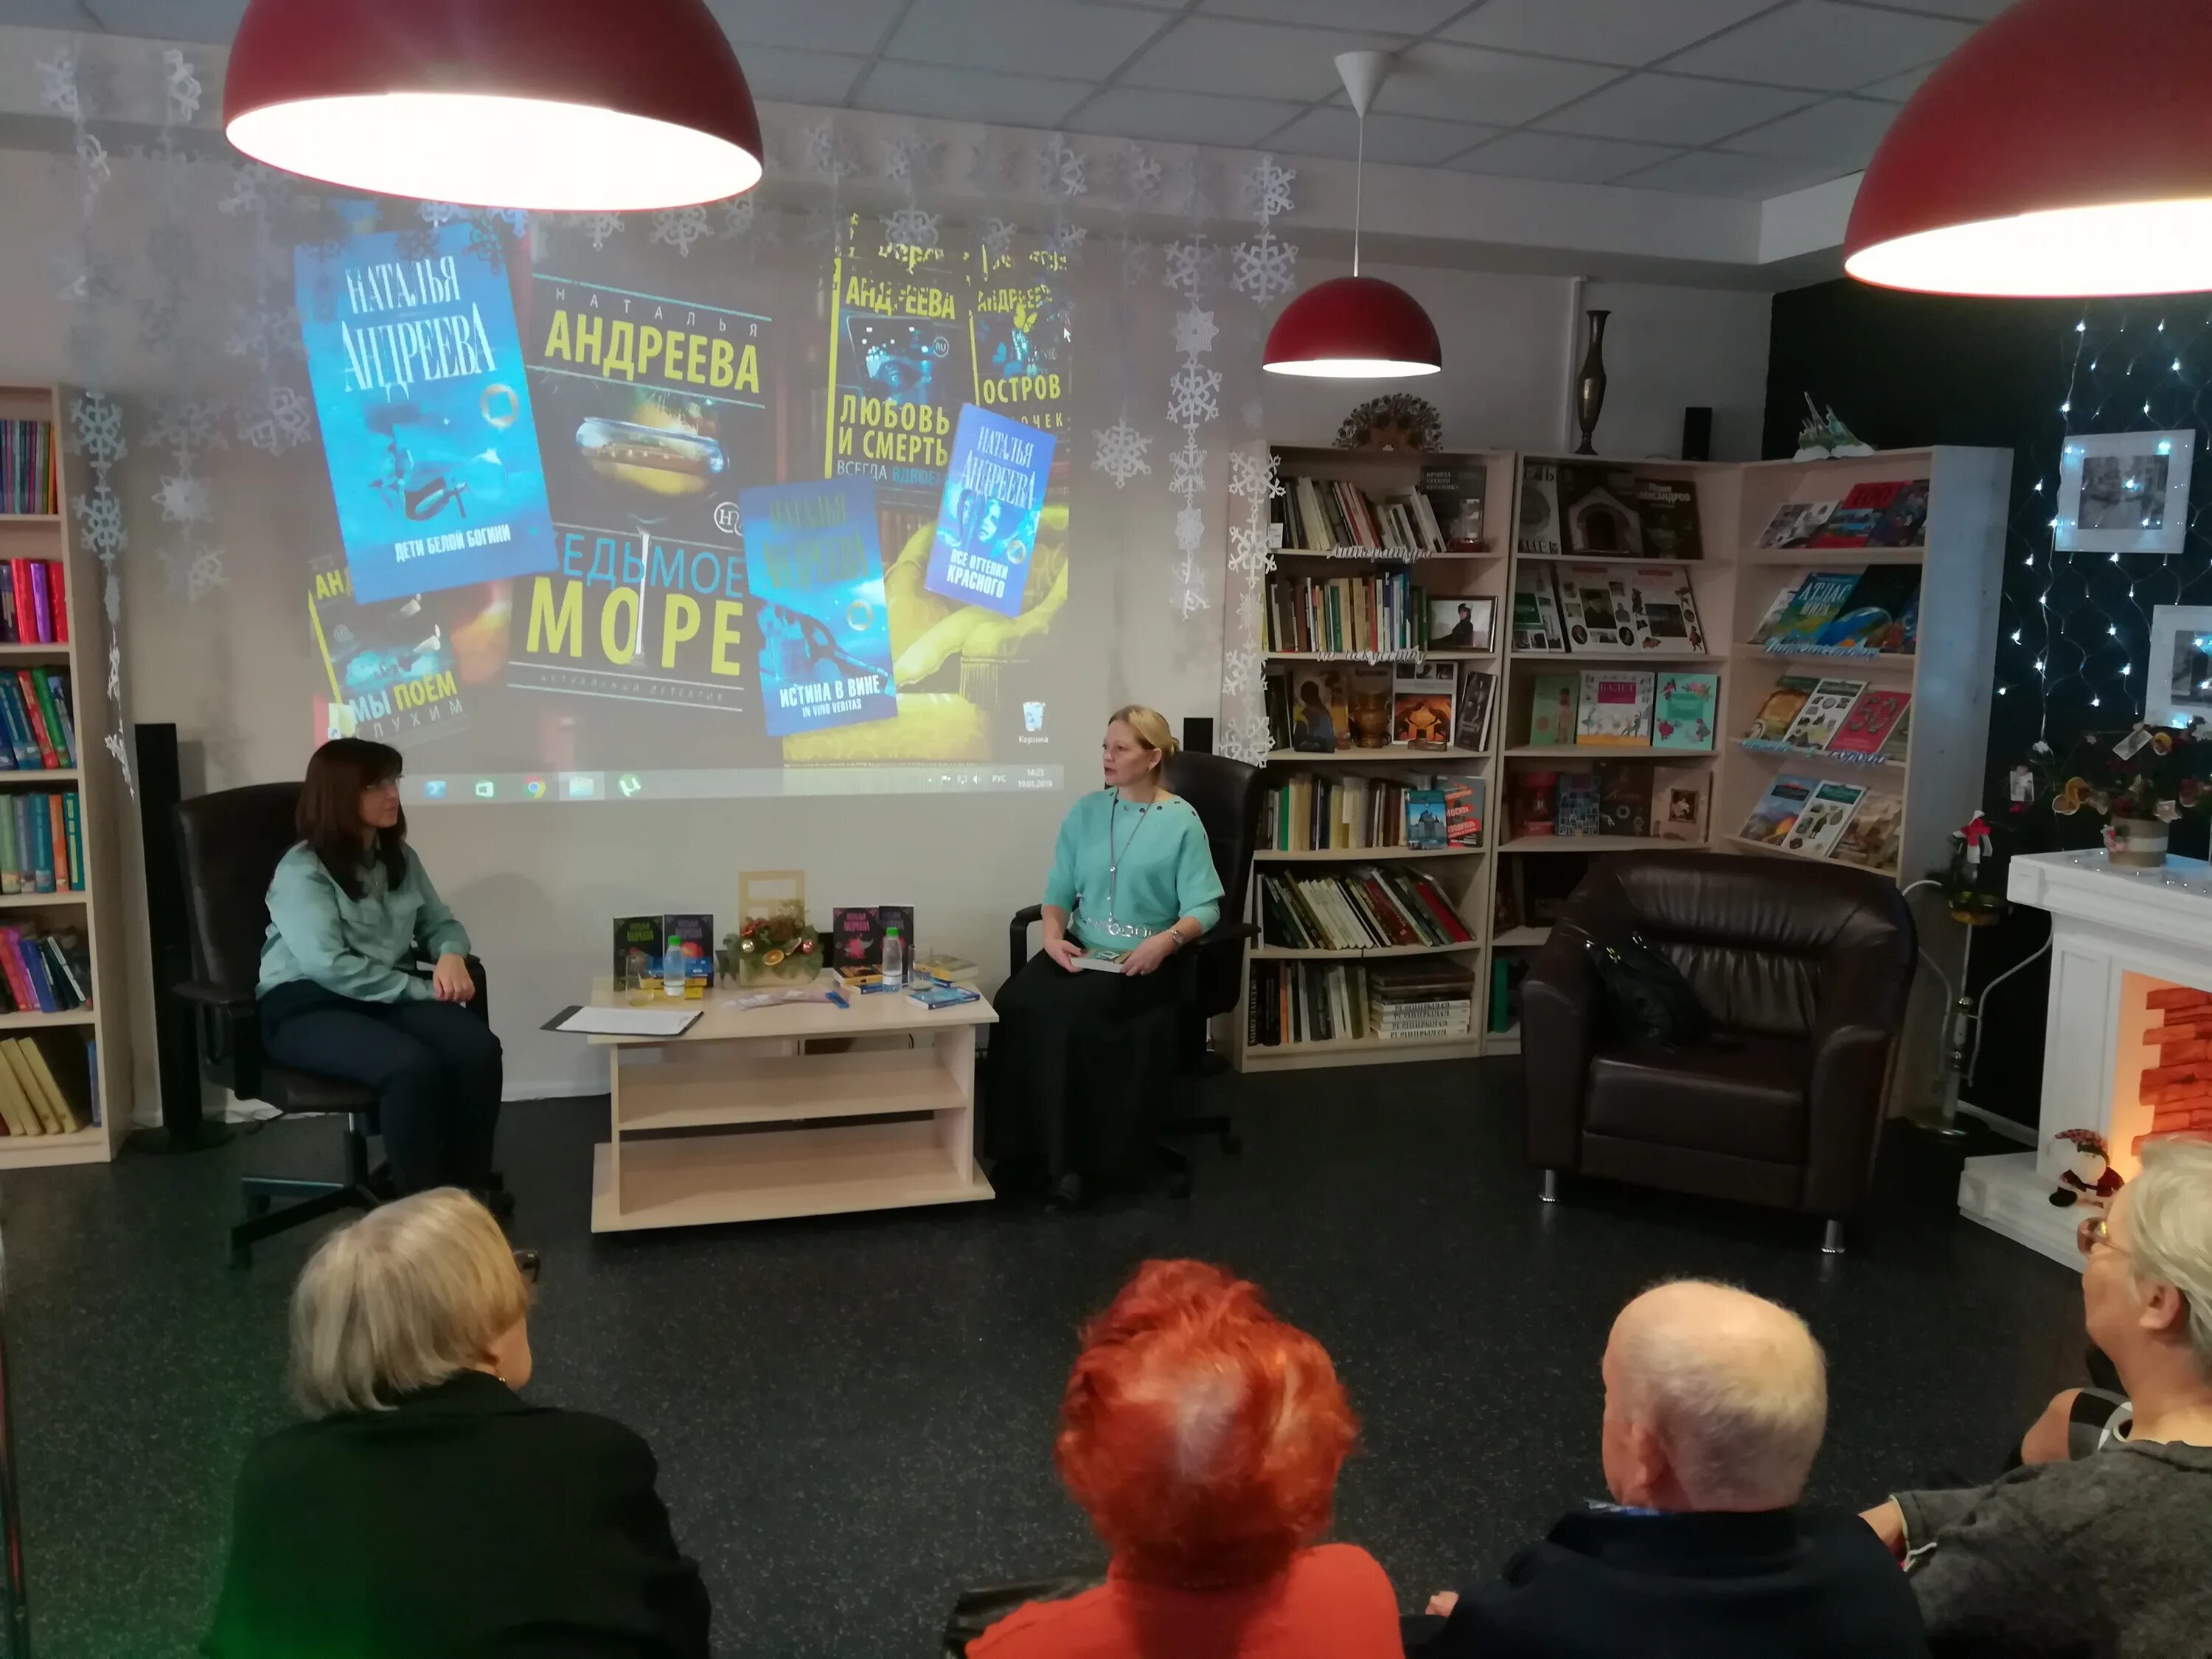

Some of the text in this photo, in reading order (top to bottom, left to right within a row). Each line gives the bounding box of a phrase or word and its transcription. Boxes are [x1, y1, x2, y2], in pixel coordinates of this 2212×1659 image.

[346, 255, 461, 315] НАТАЛЬЯ
[846, 275, 956, 320] АНДЕЕВА
[555, 287, 758, 338] НАТАЛЬЯ
[341, 302, 497, 403] АНДРЕЕВА
[544, 308, 760, 394] АНДРЕЕВА
[983, 373, 1061, 404] ОСТРОВ
[839, 394, 950, 435] ЛЮБОВЬ
[838, 426, 949, 467] И СМЕРТЬ
[978, 425, 1035, 468] НАТАЛЬЯ
[837, 459, 888, 481] ВСЕГДА
[960, 449, 1037, 511] АНДРЕЕВА
[394, 524, 511, 563] ДЕТИ БЕЛОЙ БОГИНИ
[553, 531, 744, 598] ЕДЬМОЕ
[950, 548, 1009, 579] ВСЕ ОТТЕНКИ
[946, 566, 1006, 599] КРАСНОГО
[526, 576, 743, 676] МОРЕ
[349, 670, 458, 727] МЫ ПОЕМ
[779, 674, 880, 709] ИСТИНА В ВИНЕ
[802, 698, 862, 718] IN VINO VERITAS
